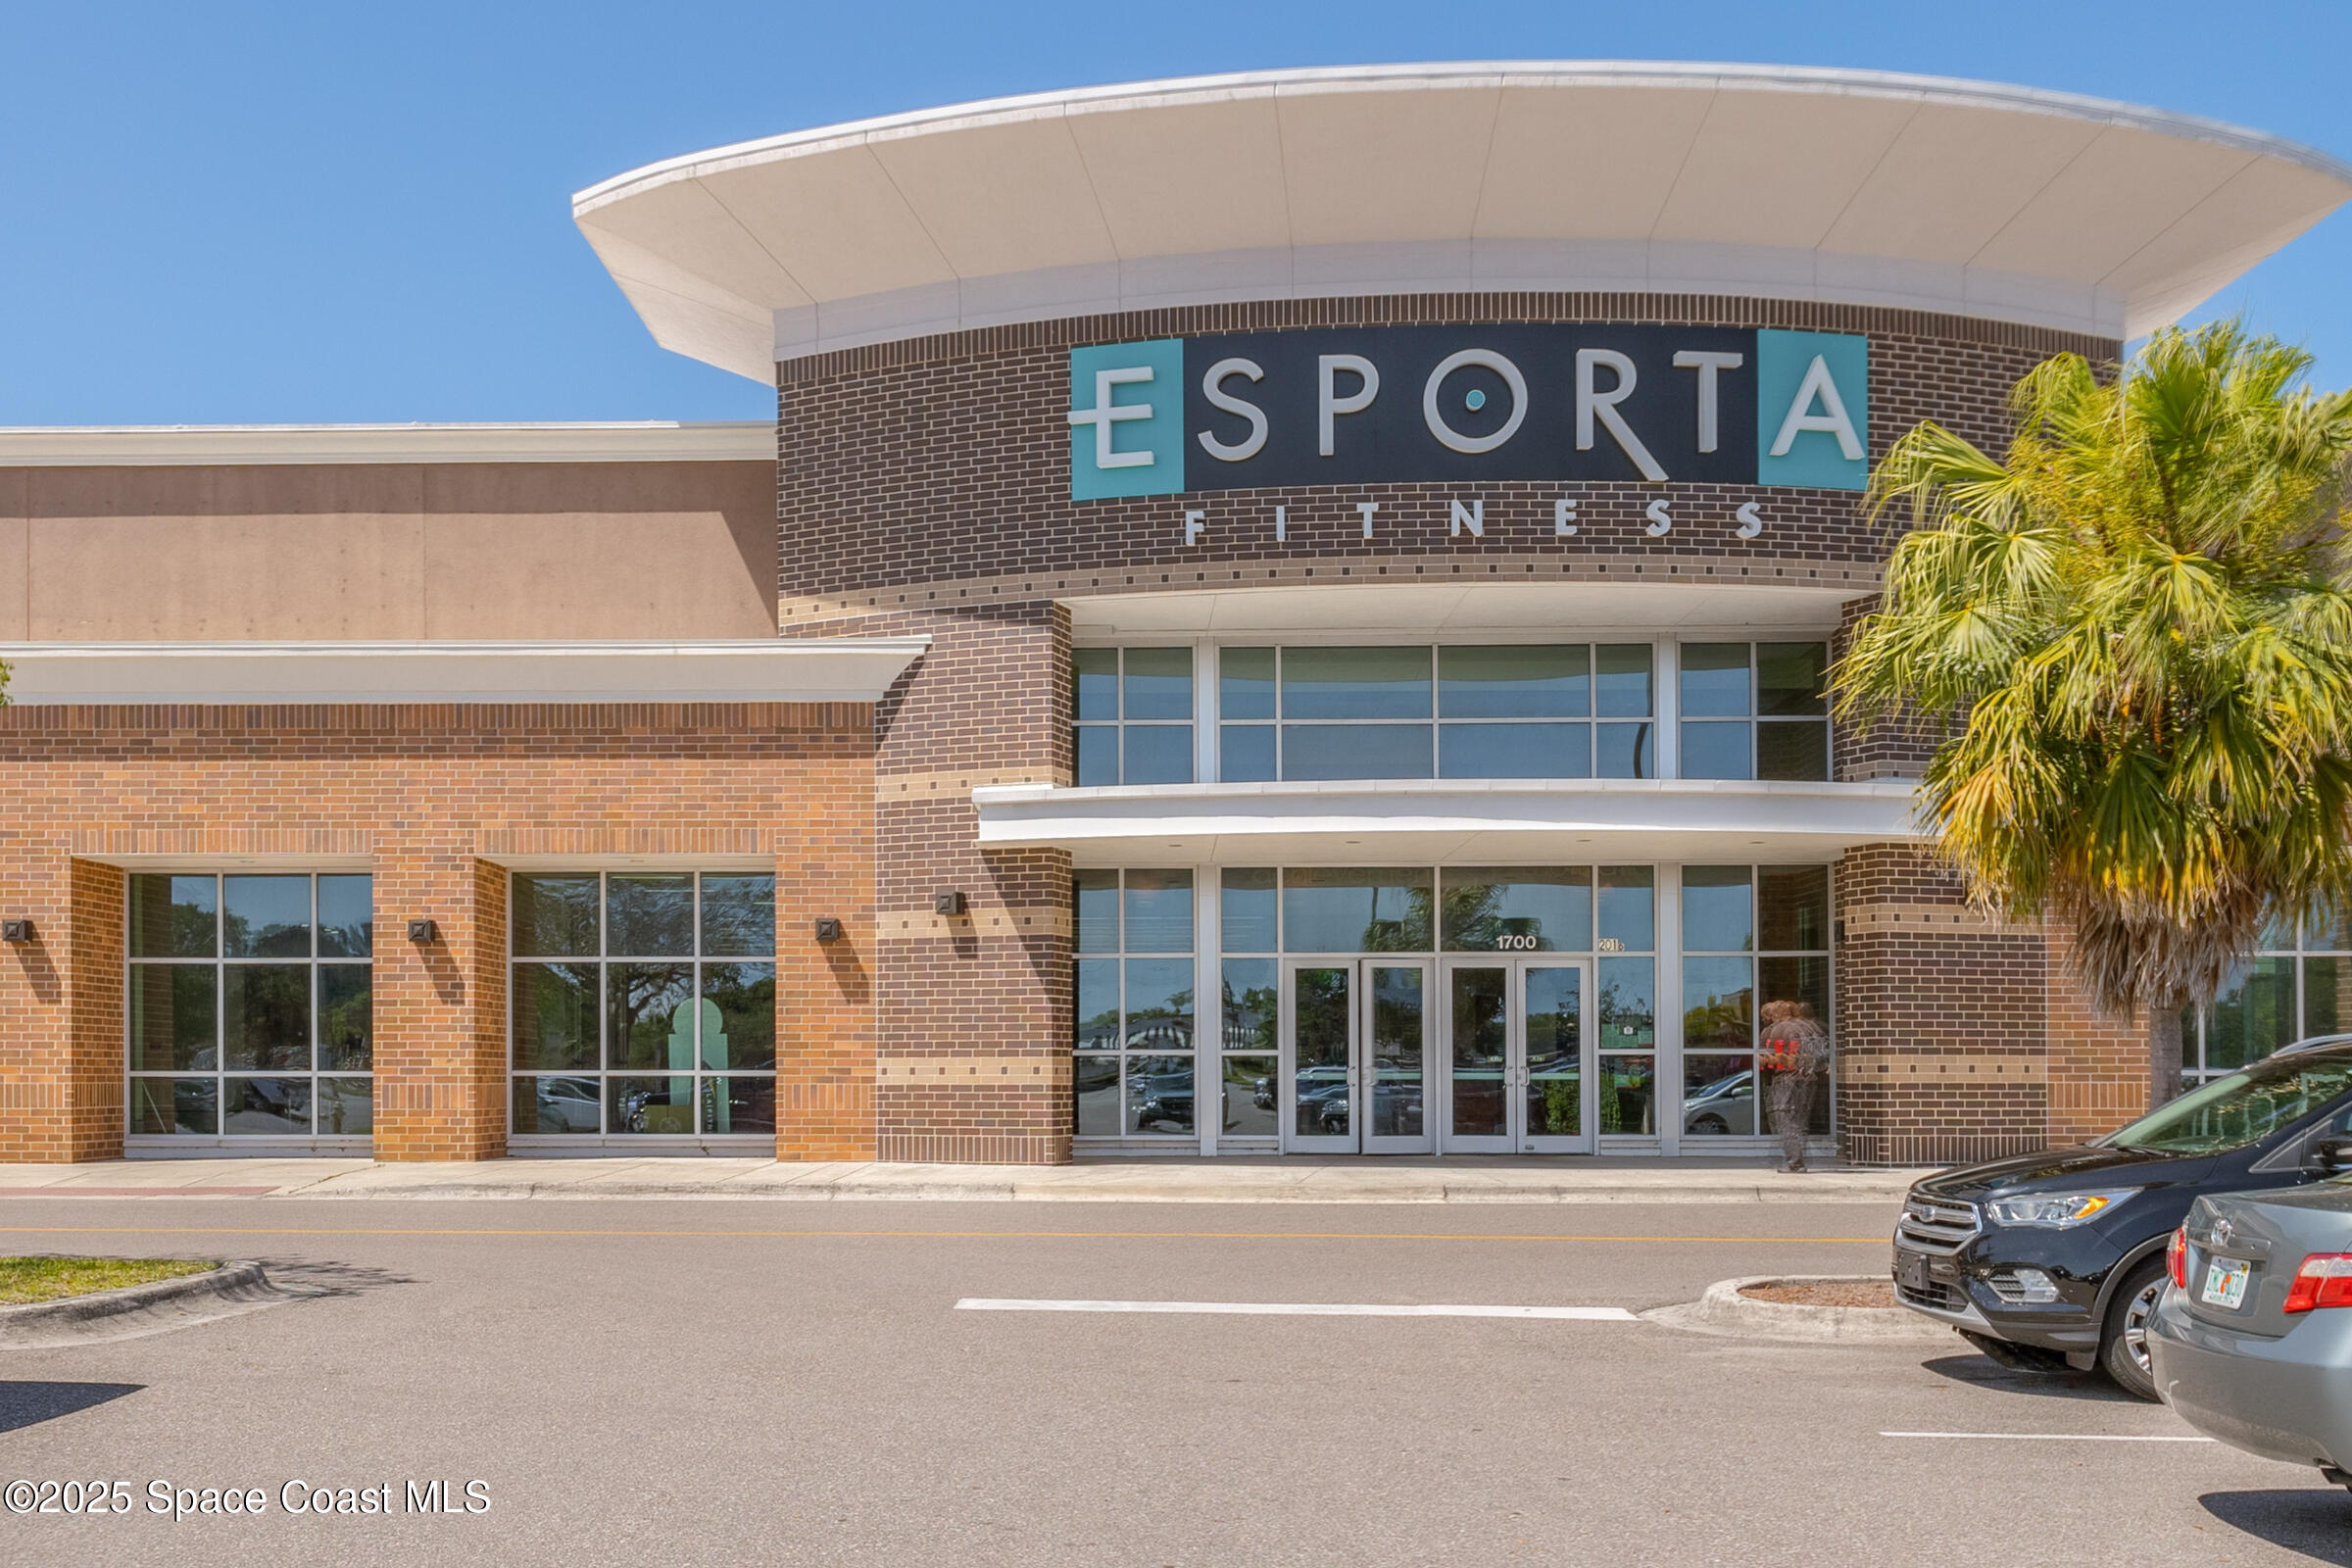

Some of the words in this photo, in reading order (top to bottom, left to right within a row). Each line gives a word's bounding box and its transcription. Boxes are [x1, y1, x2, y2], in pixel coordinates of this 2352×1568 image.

[1067, 348, 1865, 482] ESPORTA
[1184, 498, 1763, 547] FITNESS
[1495, 934, 1537, 950] 1700
